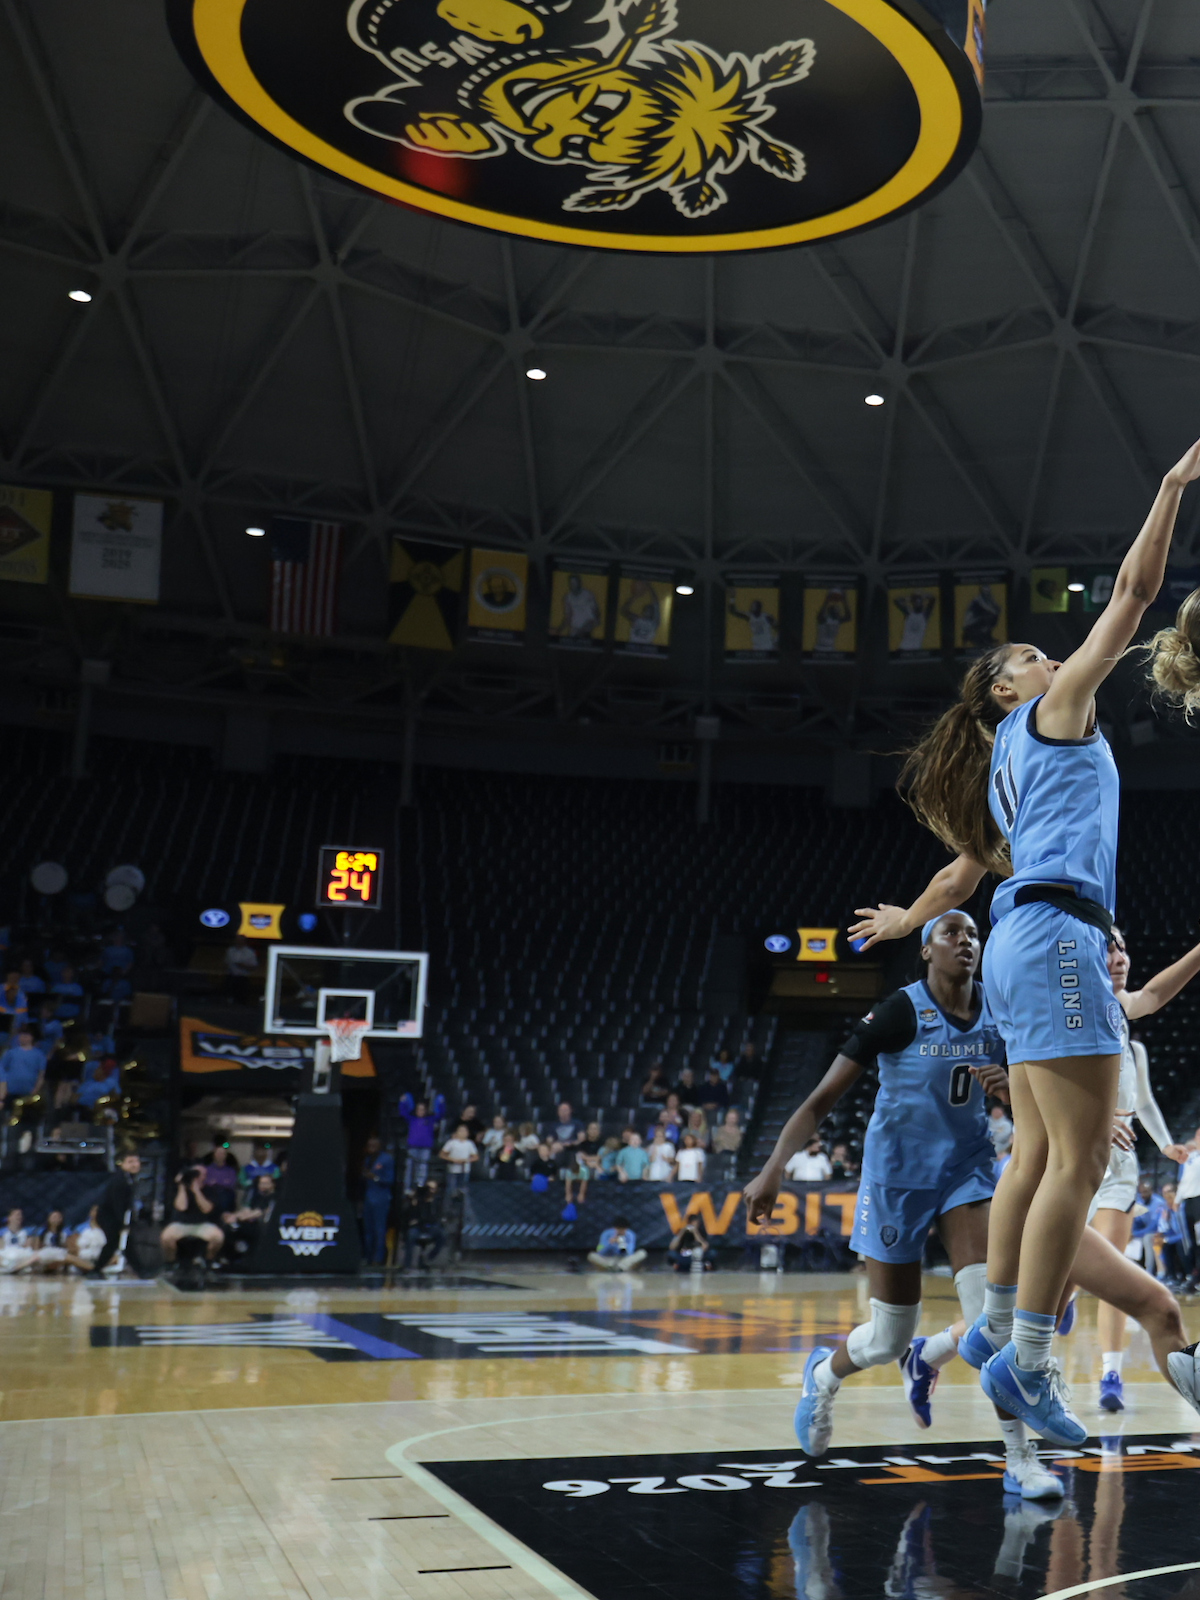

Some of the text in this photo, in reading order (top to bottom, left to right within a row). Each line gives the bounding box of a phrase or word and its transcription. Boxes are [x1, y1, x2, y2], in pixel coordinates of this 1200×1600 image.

[389, 34, 497, 74] WSU
[993, 750, 1018, 832] 11
[335, 851, 378, 872] 6:29
[327, 868, 372, 902] 24
[1057, 939, 1084, 1030] LIONS
[948, 1063, 974, 1107] 0
[278, 1225, 340, 1241] WBIT
[658, 1191, 858, 1236] WBIT
[542, 1470, 824, 1498] 2026
